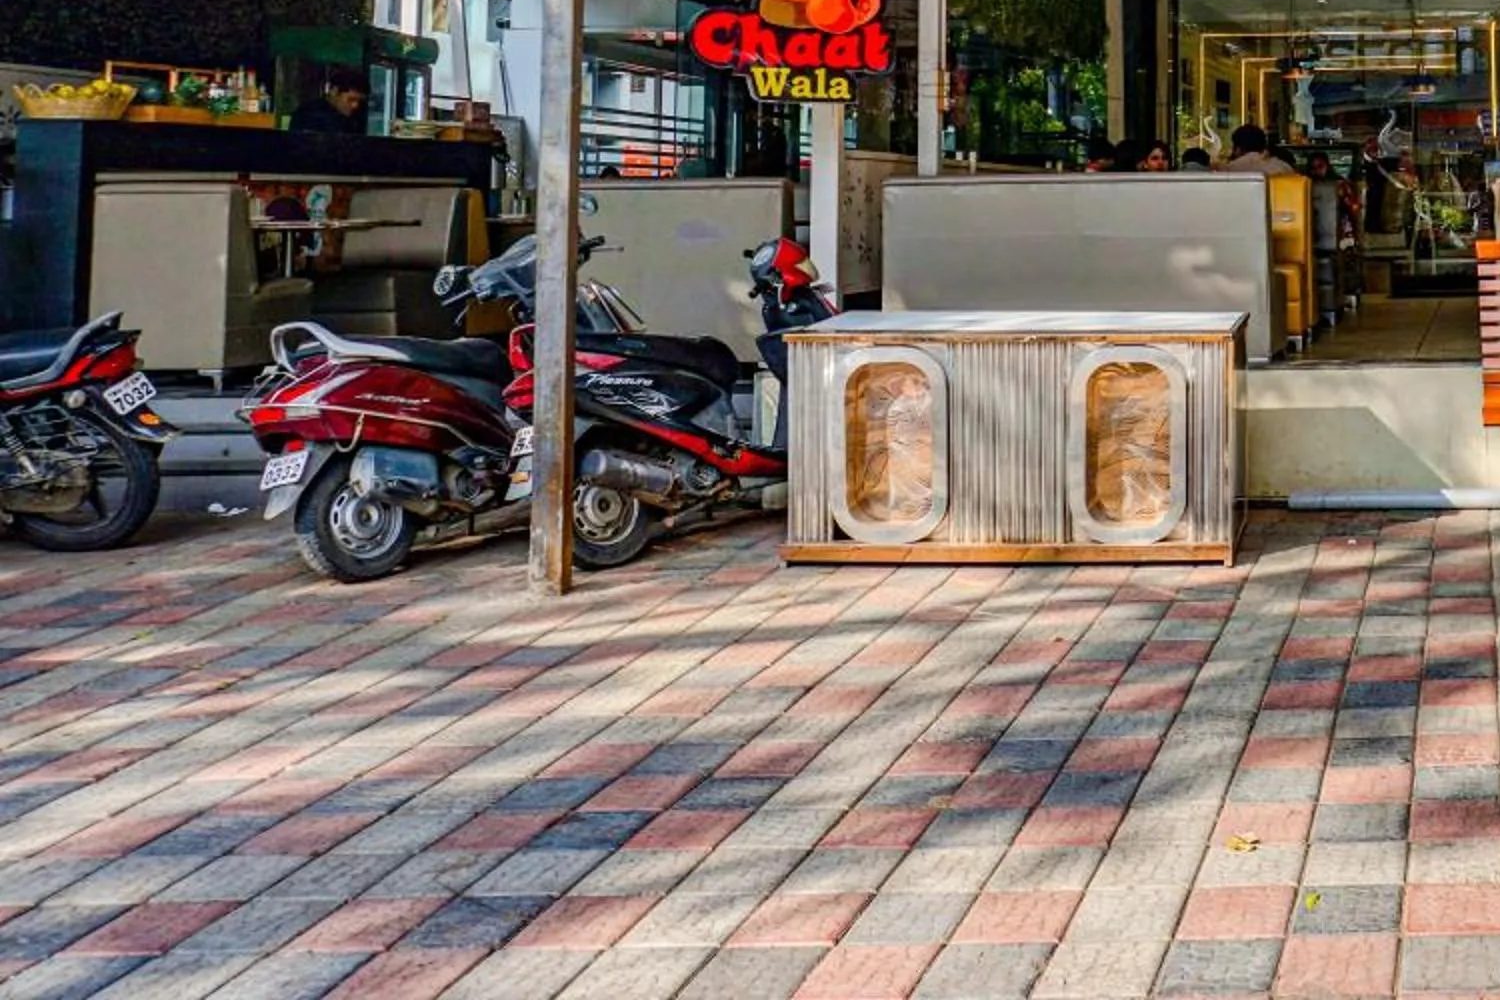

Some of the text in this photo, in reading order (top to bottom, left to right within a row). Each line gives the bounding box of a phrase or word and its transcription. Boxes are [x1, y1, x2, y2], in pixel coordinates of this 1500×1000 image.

[691, 11, 890, 71] Chaat
[750, 66, 853, 100] Wala
[113, 381, 153, 412] 7032
